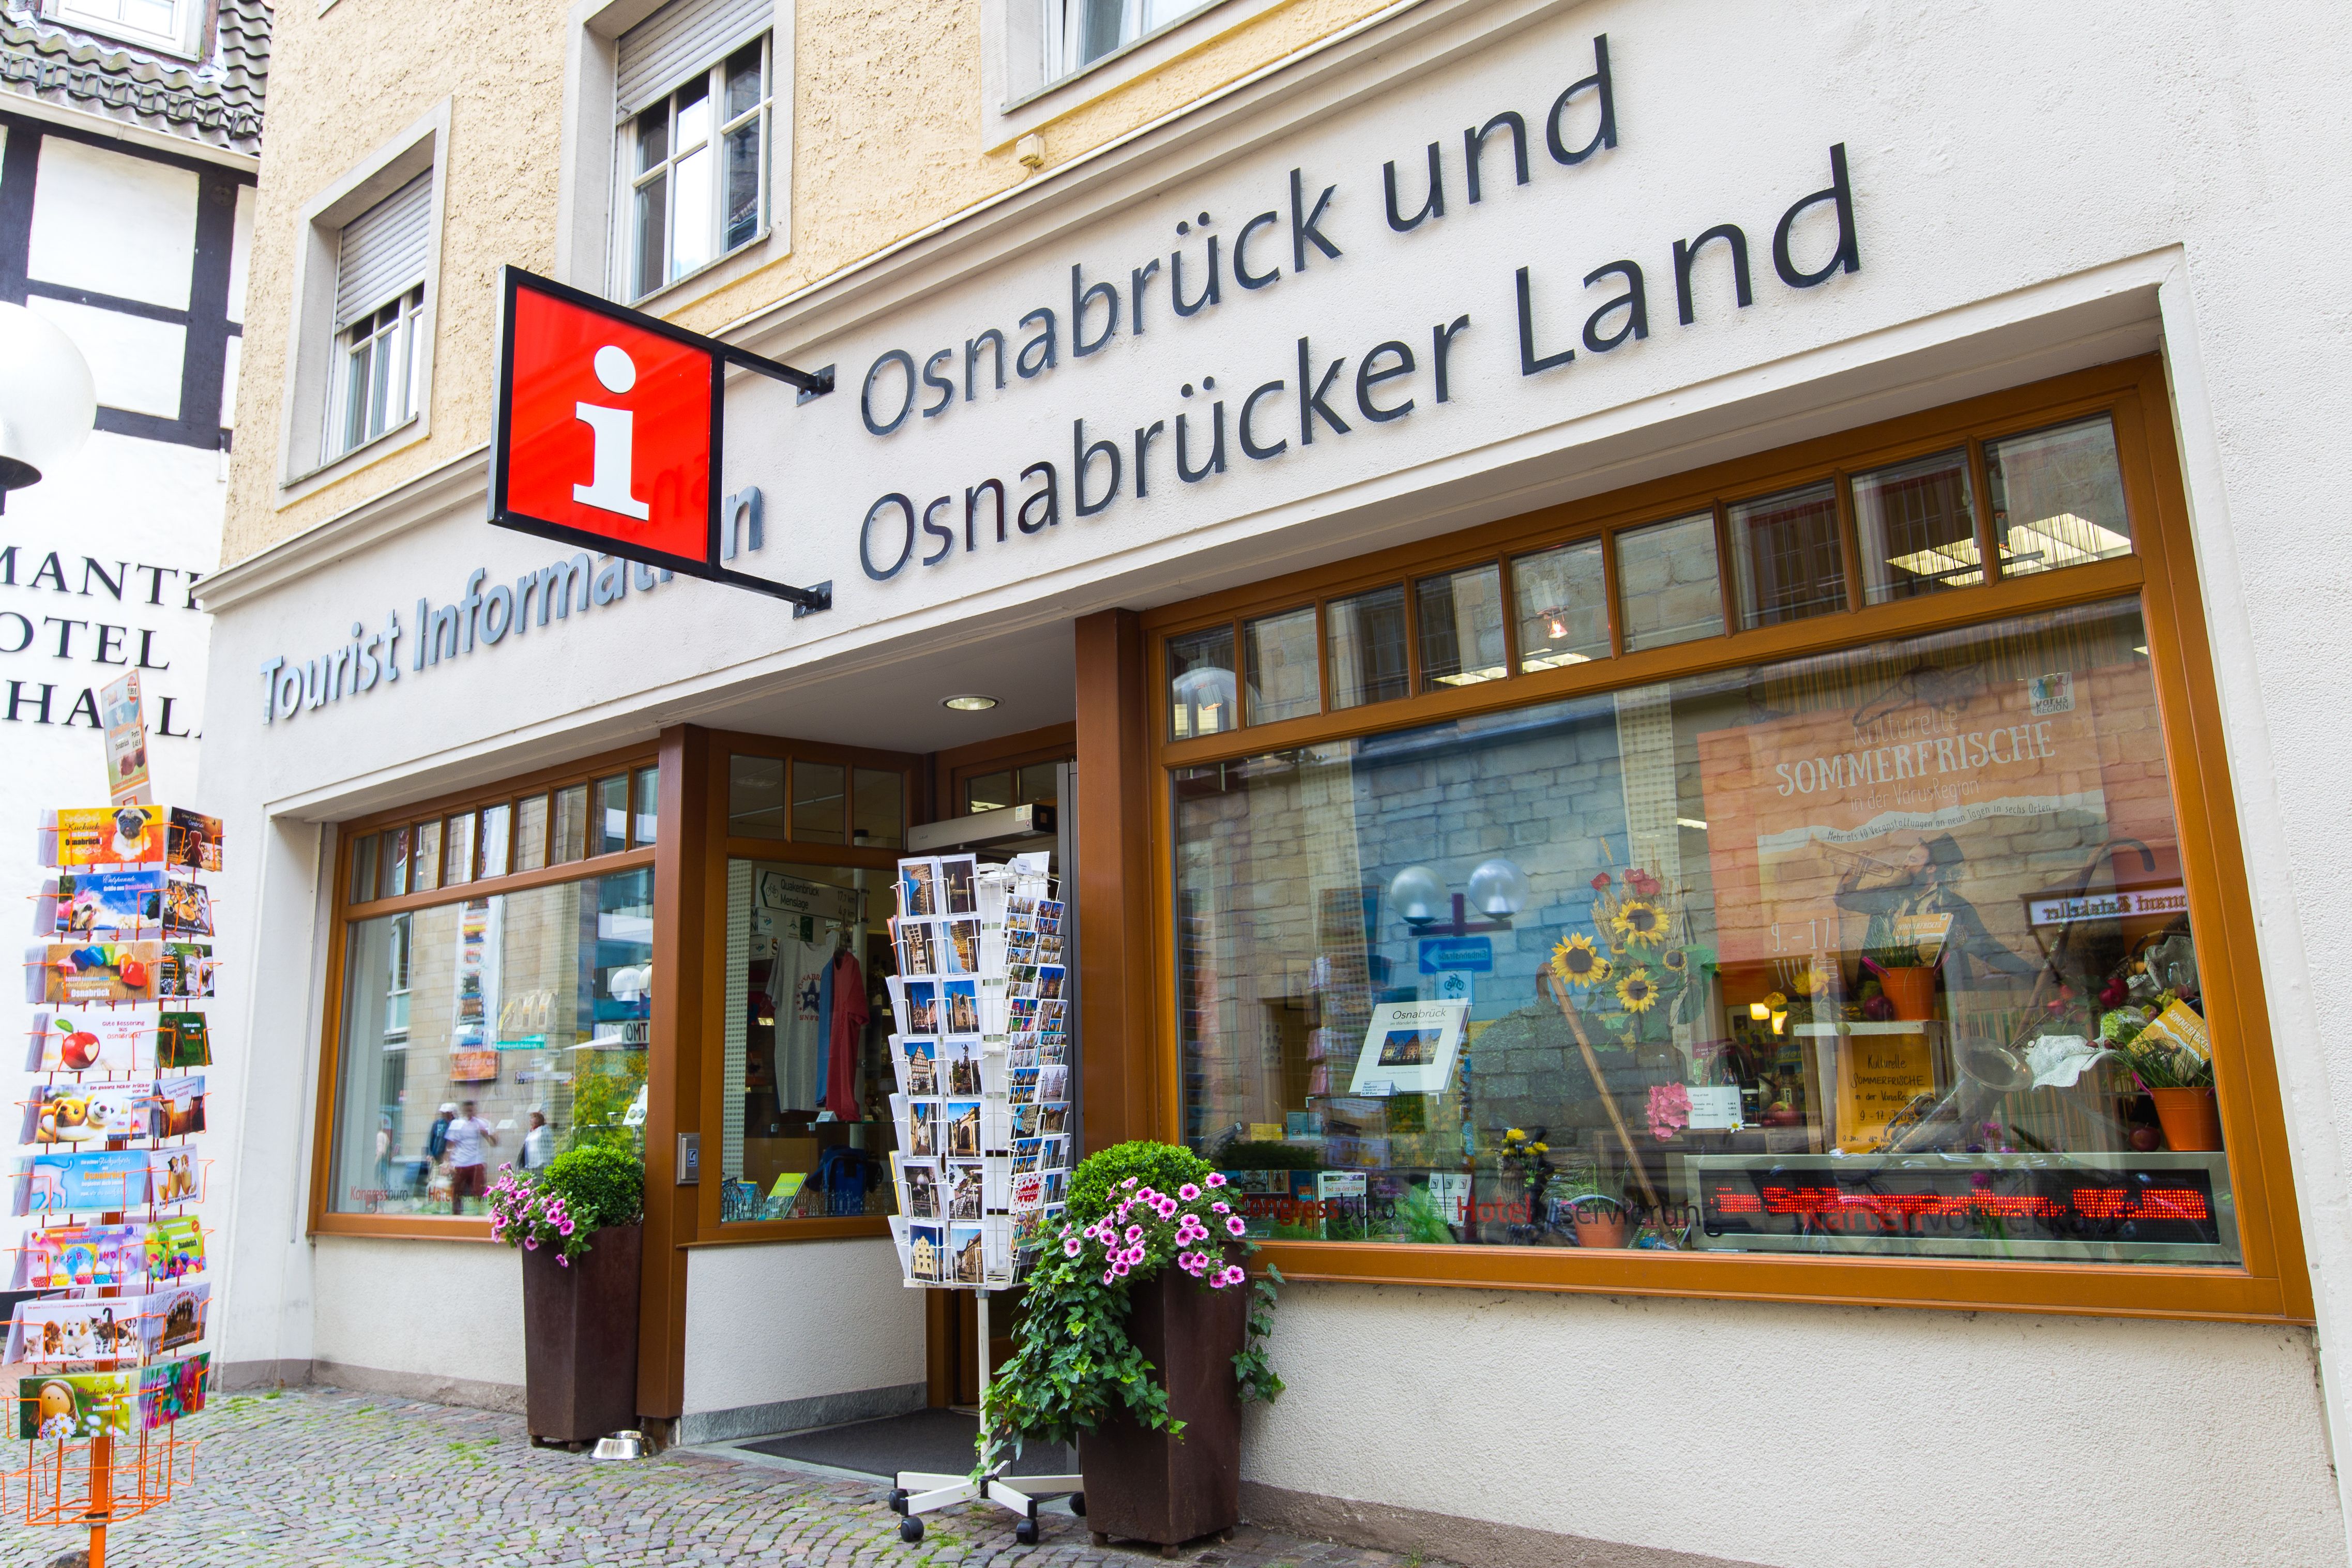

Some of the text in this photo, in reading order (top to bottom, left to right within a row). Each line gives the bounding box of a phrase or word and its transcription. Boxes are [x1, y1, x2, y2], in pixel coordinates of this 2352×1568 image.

[860, 32, 1619, 437] Osnabrück und
[859, 142, 1861, 582] Osnabrücker Land
[260, 485, 763, 725] Tourist Informan
[2, 679, 202, 739] HAL
[2036, 695, 2068, 707] varus
[2036, 702, 2069, 714] REGION
[1853, 706, 1959, 747] Kulturelle
[1776, 720, 2056, 796] SOMMERFRISCHE
[1850, 778, 1979, 811] in der VarusRegion
[1828, 831, 1844, 842] Mehr
[1847, 832, 1858, 842] als
[1860, 828, 1868, 839] 40
[1869, 816, 1933, 835] Veranstaltungen
[1948, 814, 1966, 825] neun
[1967, 806, 1990, 819] Tagen
[2005, 804, 2025, 814] sechs
[2028, 802, 2051, 814] Orten
[780, 893, 809, 911] Menslage
[1809, 917, 1837, 950] 17.
[1392, 1008, 1447, 1019] Osnabrück
[1865, 1092, 1877, 1101] der
[350, 1185, 408, 1206] Kongressbüro
